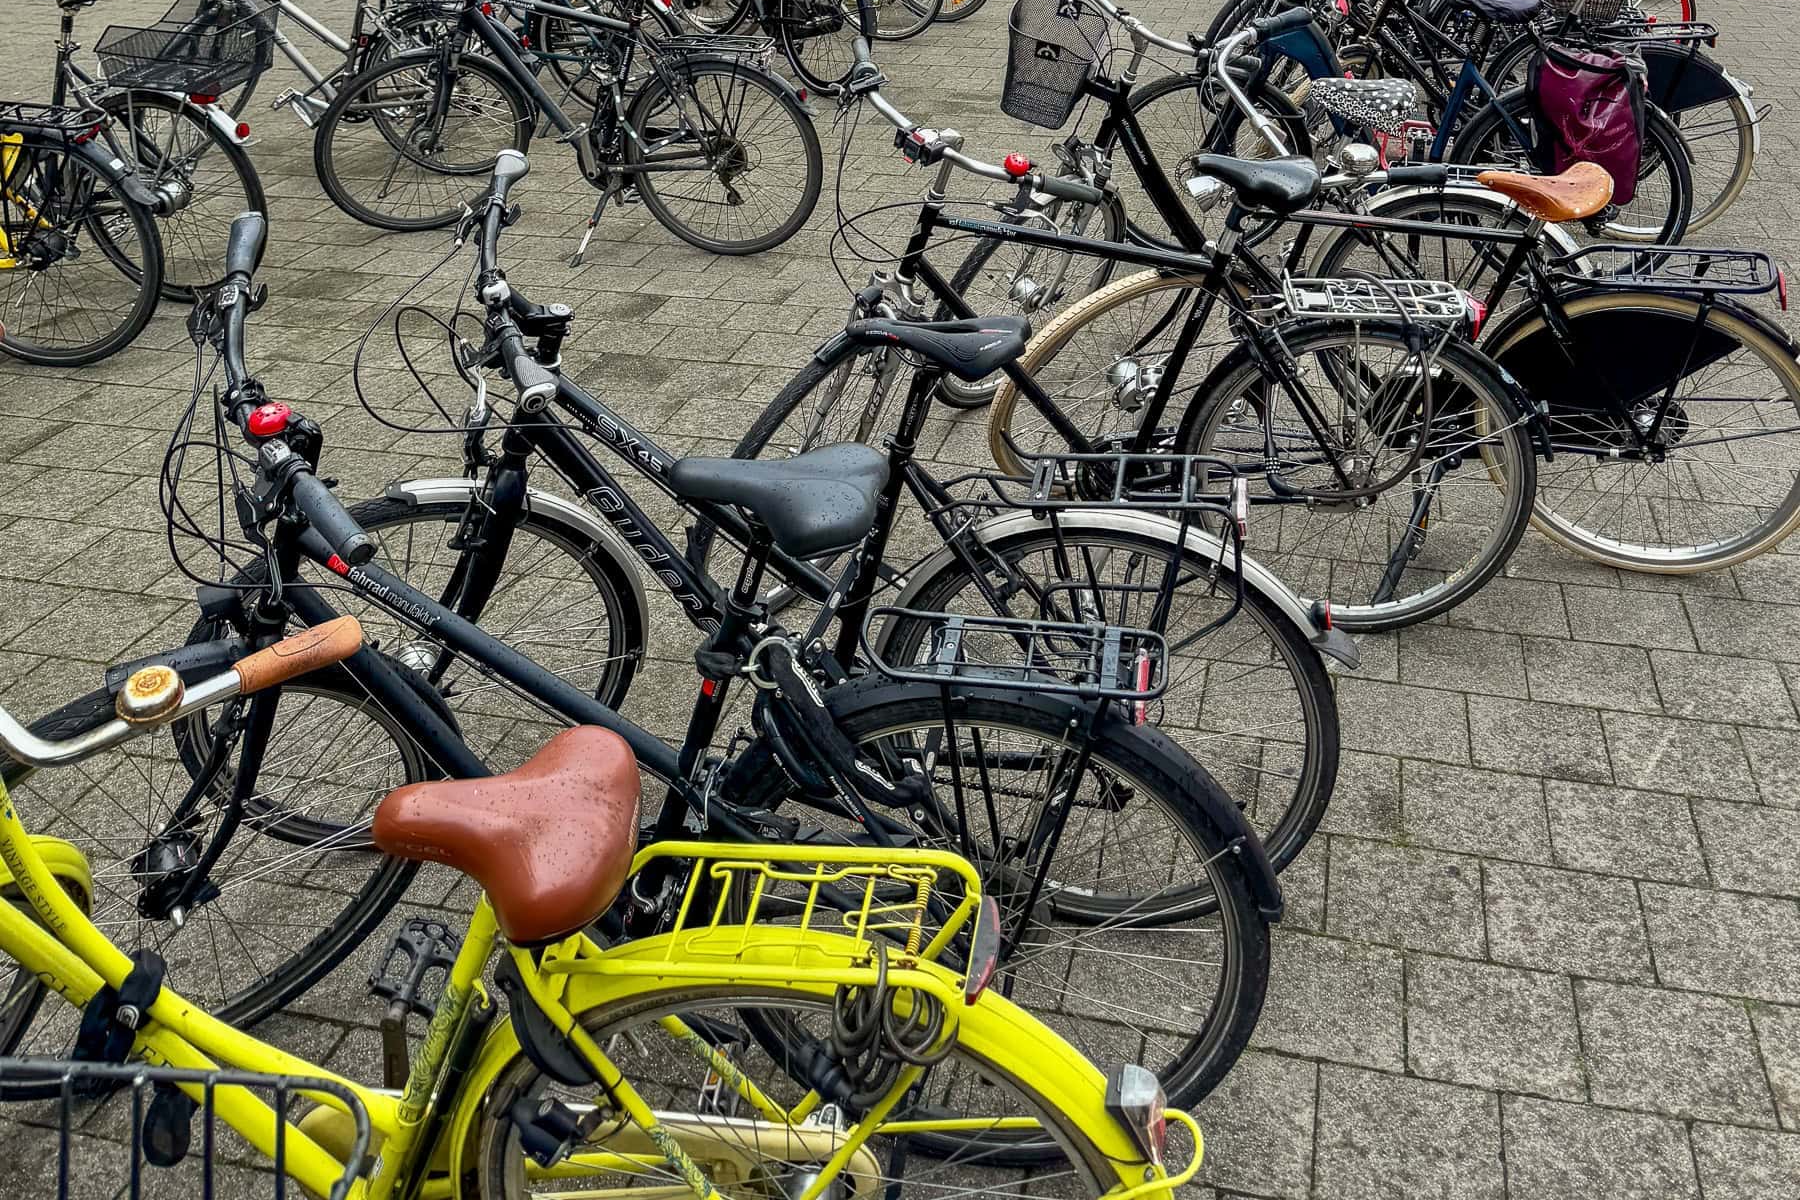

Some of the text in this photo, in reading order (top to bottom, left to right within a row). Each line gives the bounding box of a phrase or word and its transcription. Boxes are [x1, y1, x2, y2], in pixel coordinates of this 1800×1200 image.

[597, 414, 640, 460] SX
[2, 838, 37, 892] VINTAGE
[35, 894, 67, 934] STYLE
